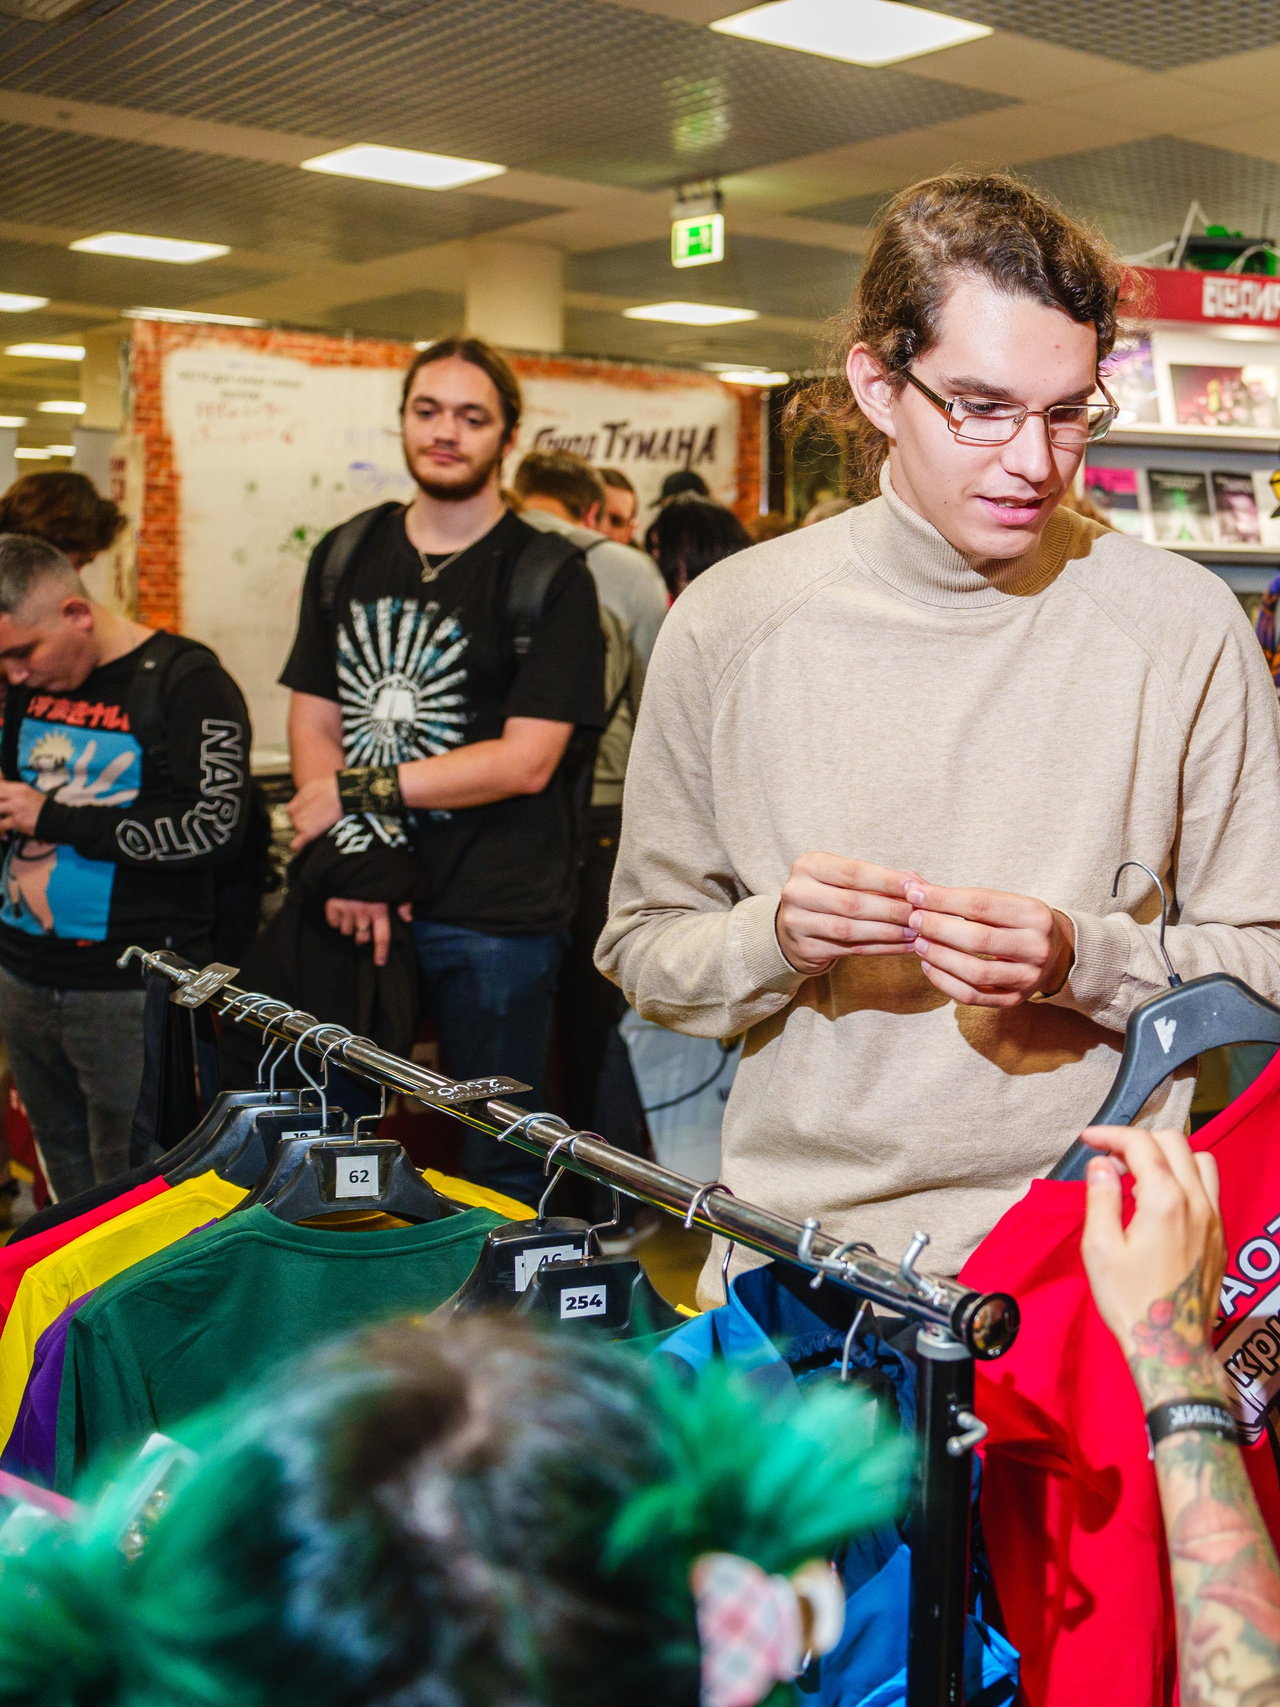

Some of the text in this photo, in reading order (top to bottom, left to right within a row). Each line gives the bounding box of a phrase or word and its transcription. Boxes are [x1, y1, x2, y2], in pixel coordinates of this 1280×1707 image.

[115, 718, 244, 862] NARUTO
[348, 1169, 370, 1184] 62
[565, 1294, 603, 1311] 254
